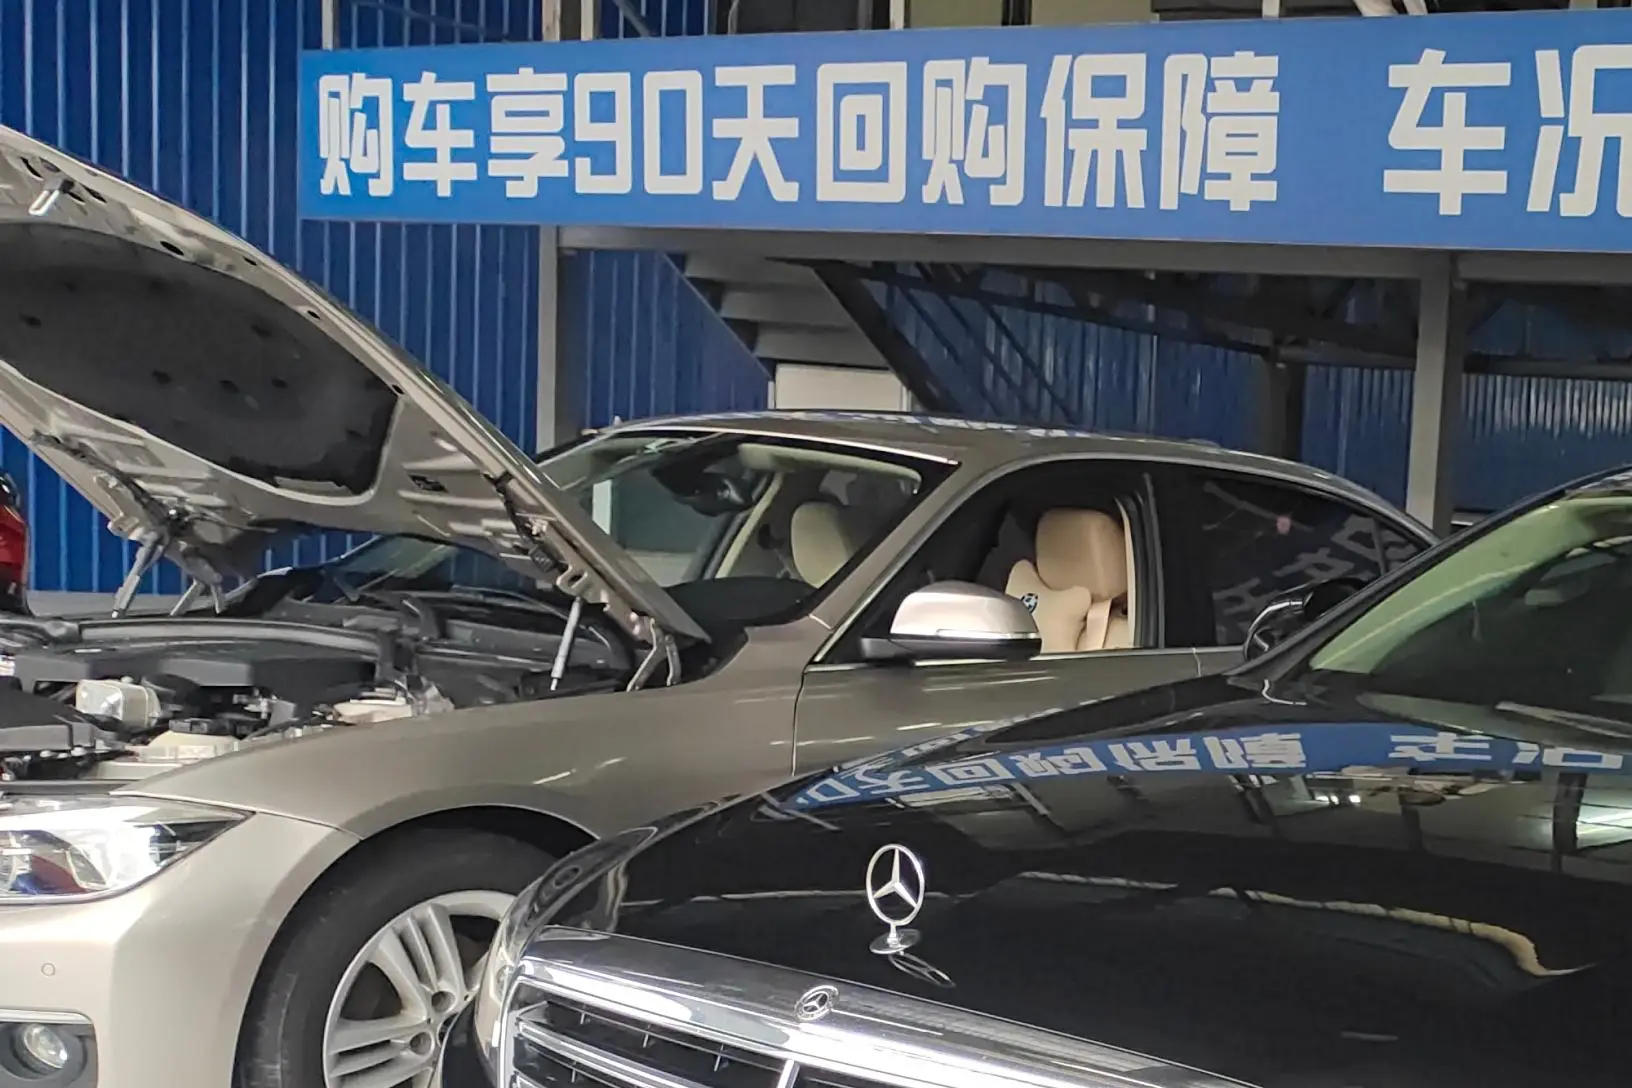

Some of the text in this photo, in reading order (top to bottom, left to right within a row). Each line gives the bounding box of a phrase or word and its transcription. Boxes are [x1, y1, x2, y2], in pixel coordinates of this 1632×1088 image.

[319, 50, 1280, 212] 购车享90天回购保障
